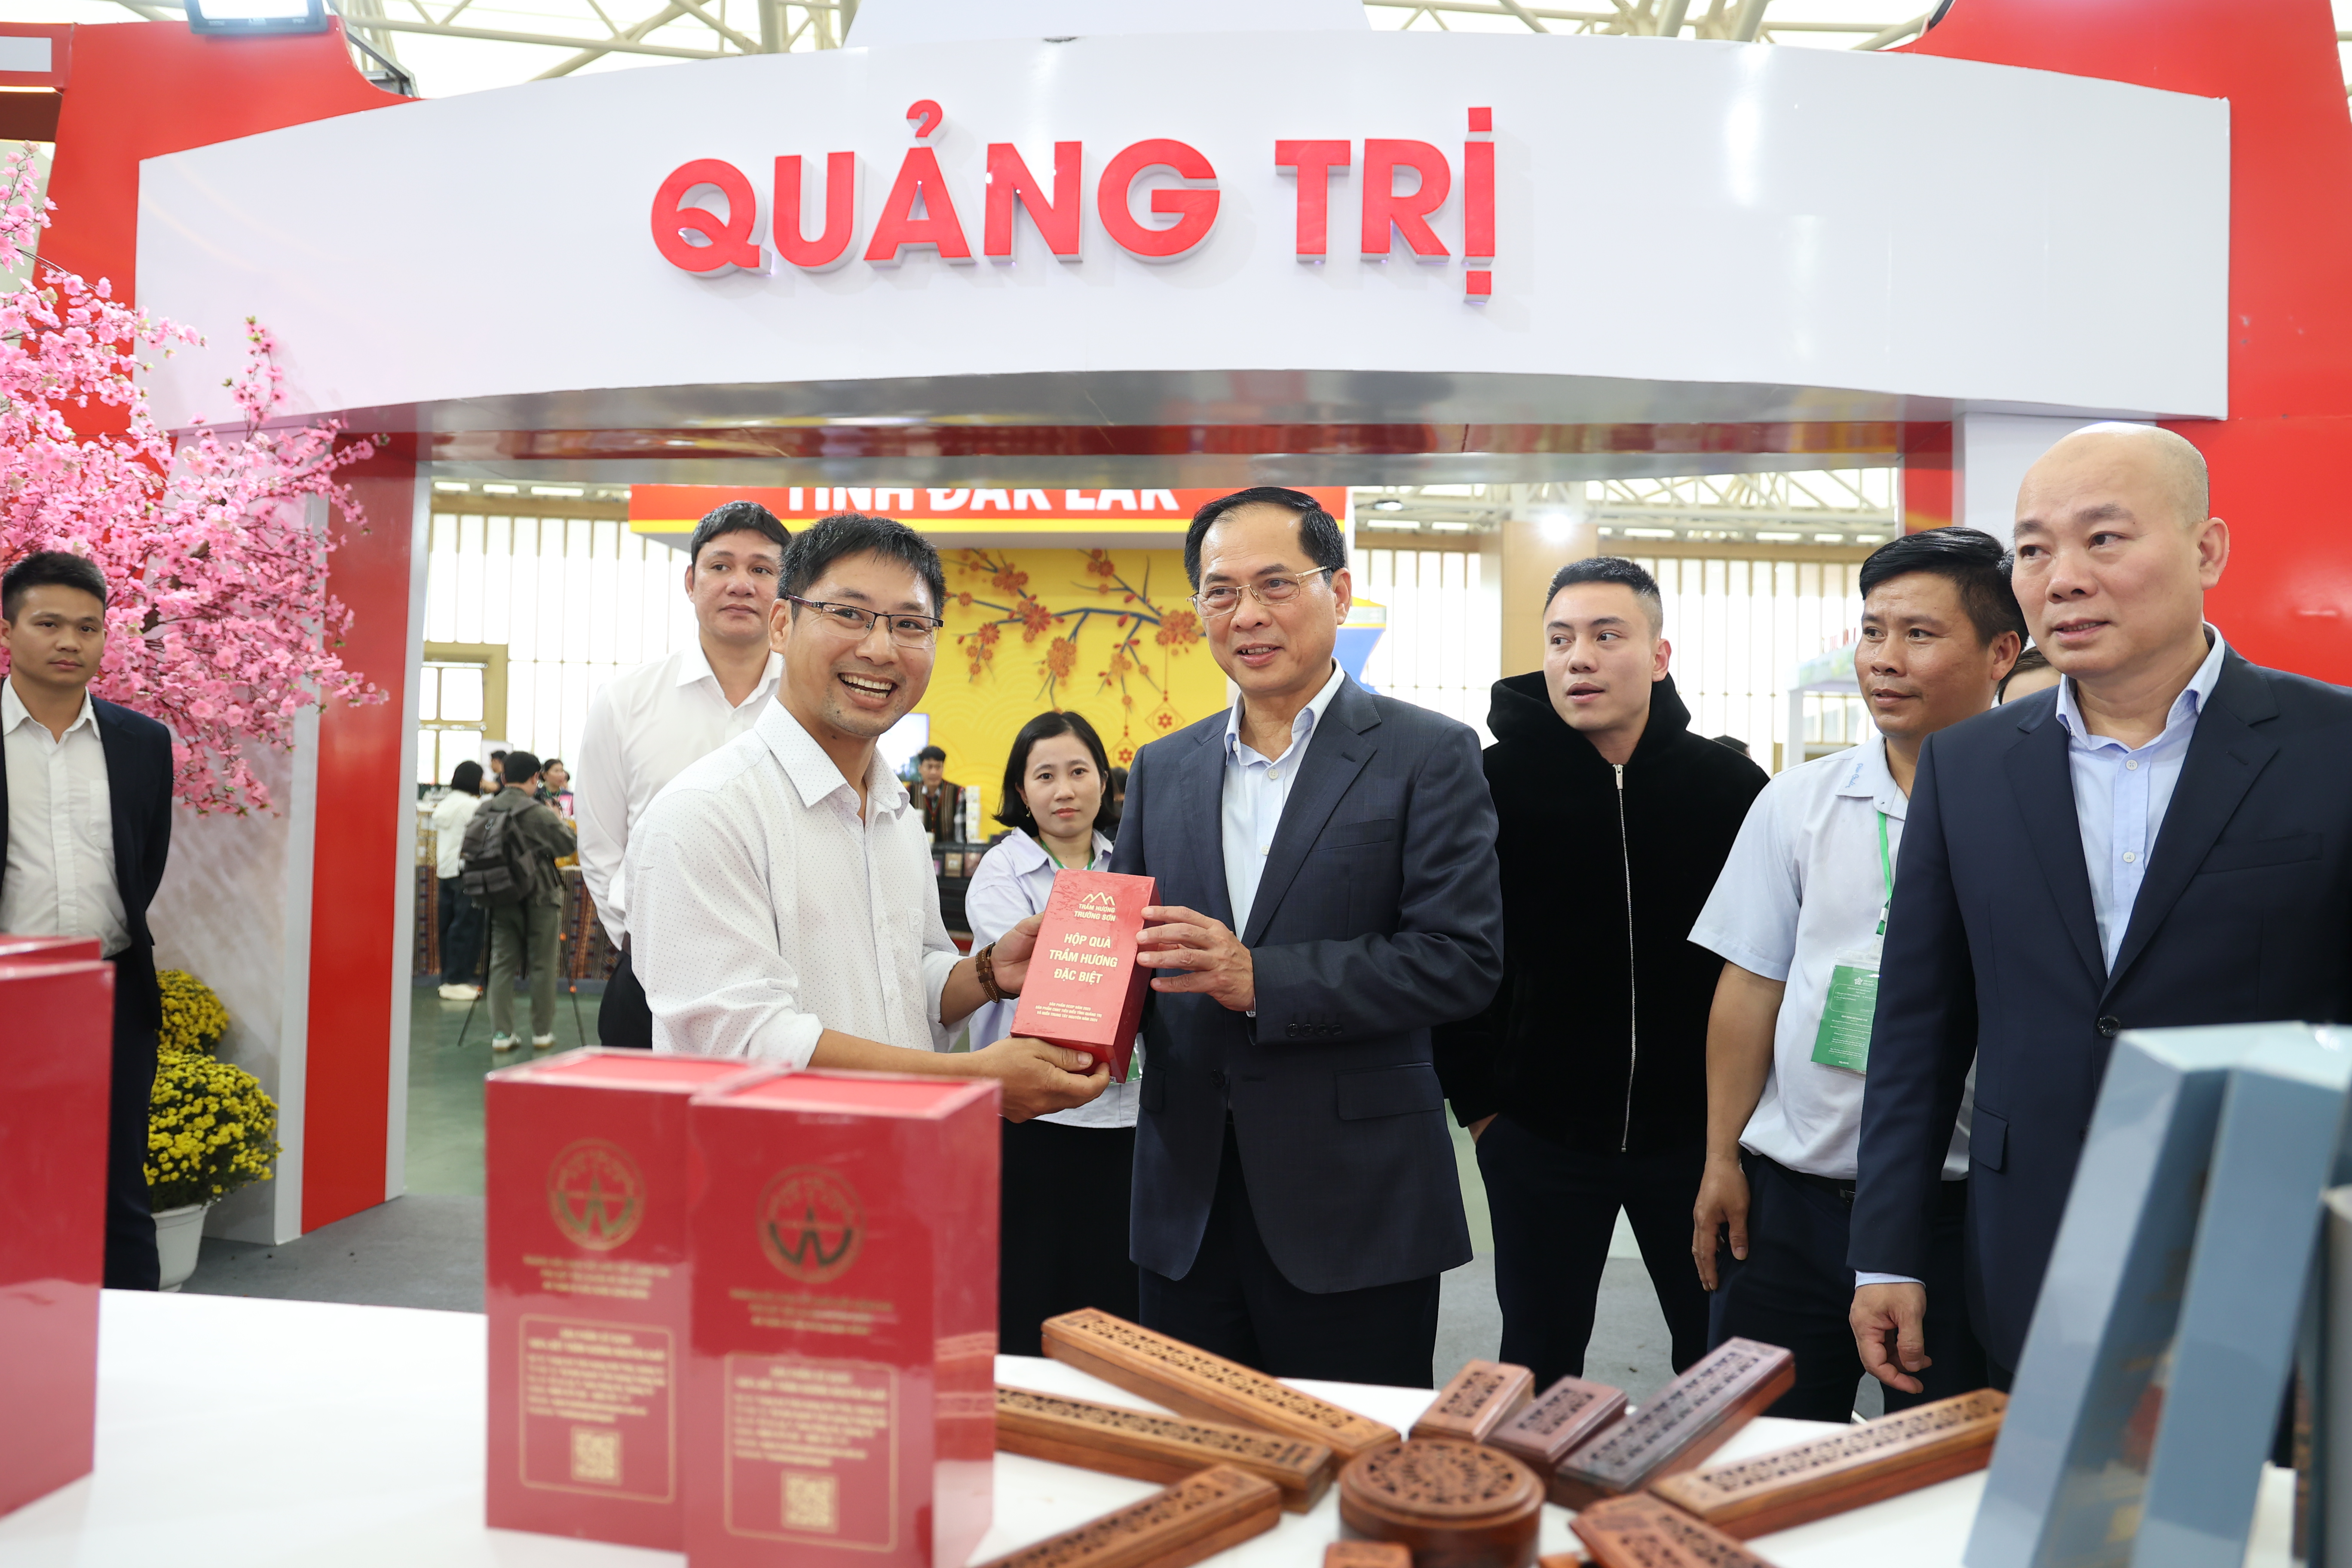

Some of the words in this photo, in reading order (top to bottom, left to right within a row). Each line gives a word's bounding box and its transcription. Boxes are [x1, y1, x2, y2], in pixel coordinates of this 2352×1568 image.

[650, 99, 1220, 272] QUẢNG
[1275, 107, 1495, 294] TRỊ
[1074, 911, 1100, 920] TRƯỜNG
[1064, 932, 1087, 946] HỘP
[1089, 936, 1111, 948] QUÀ
[1049, 948, 1079, 962] TRẦM
[1080, 953, 1118, 967] HƯƠNG
[1054, 967, 1077, 982] ĐẶC
[1078, 971, 1103, 985] BIỆT
